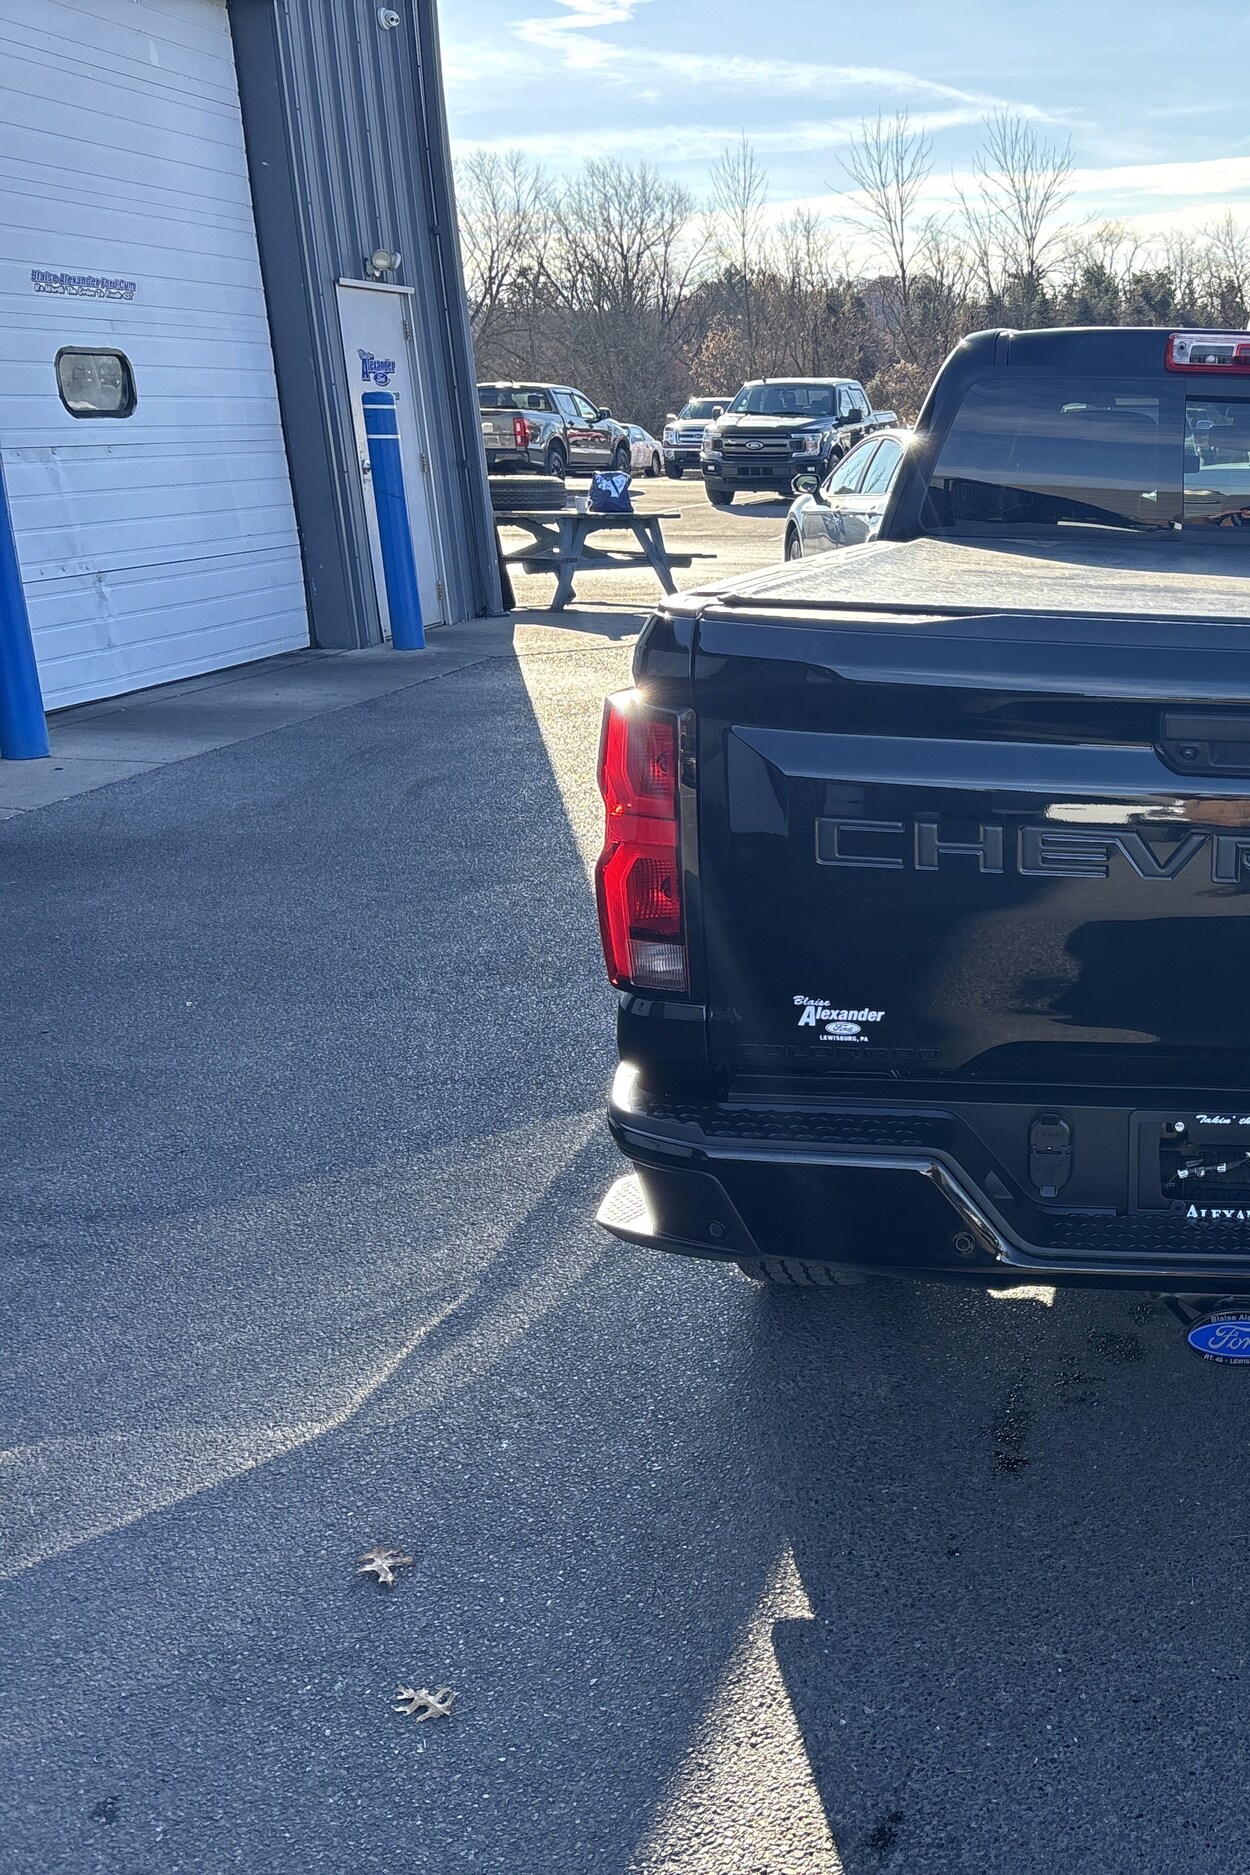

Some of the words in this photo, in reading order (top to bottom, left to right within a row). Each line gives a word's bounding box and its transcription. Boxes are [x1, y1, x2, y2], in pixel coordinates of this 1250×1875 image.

[793, 995, 831, 1006] Blaise
[798, 1005, 885, 1026] Alexander
[819, 1034, 859, 1042] LEWISBURG,
[1195, 1114, 1237, 1124] Takin'
